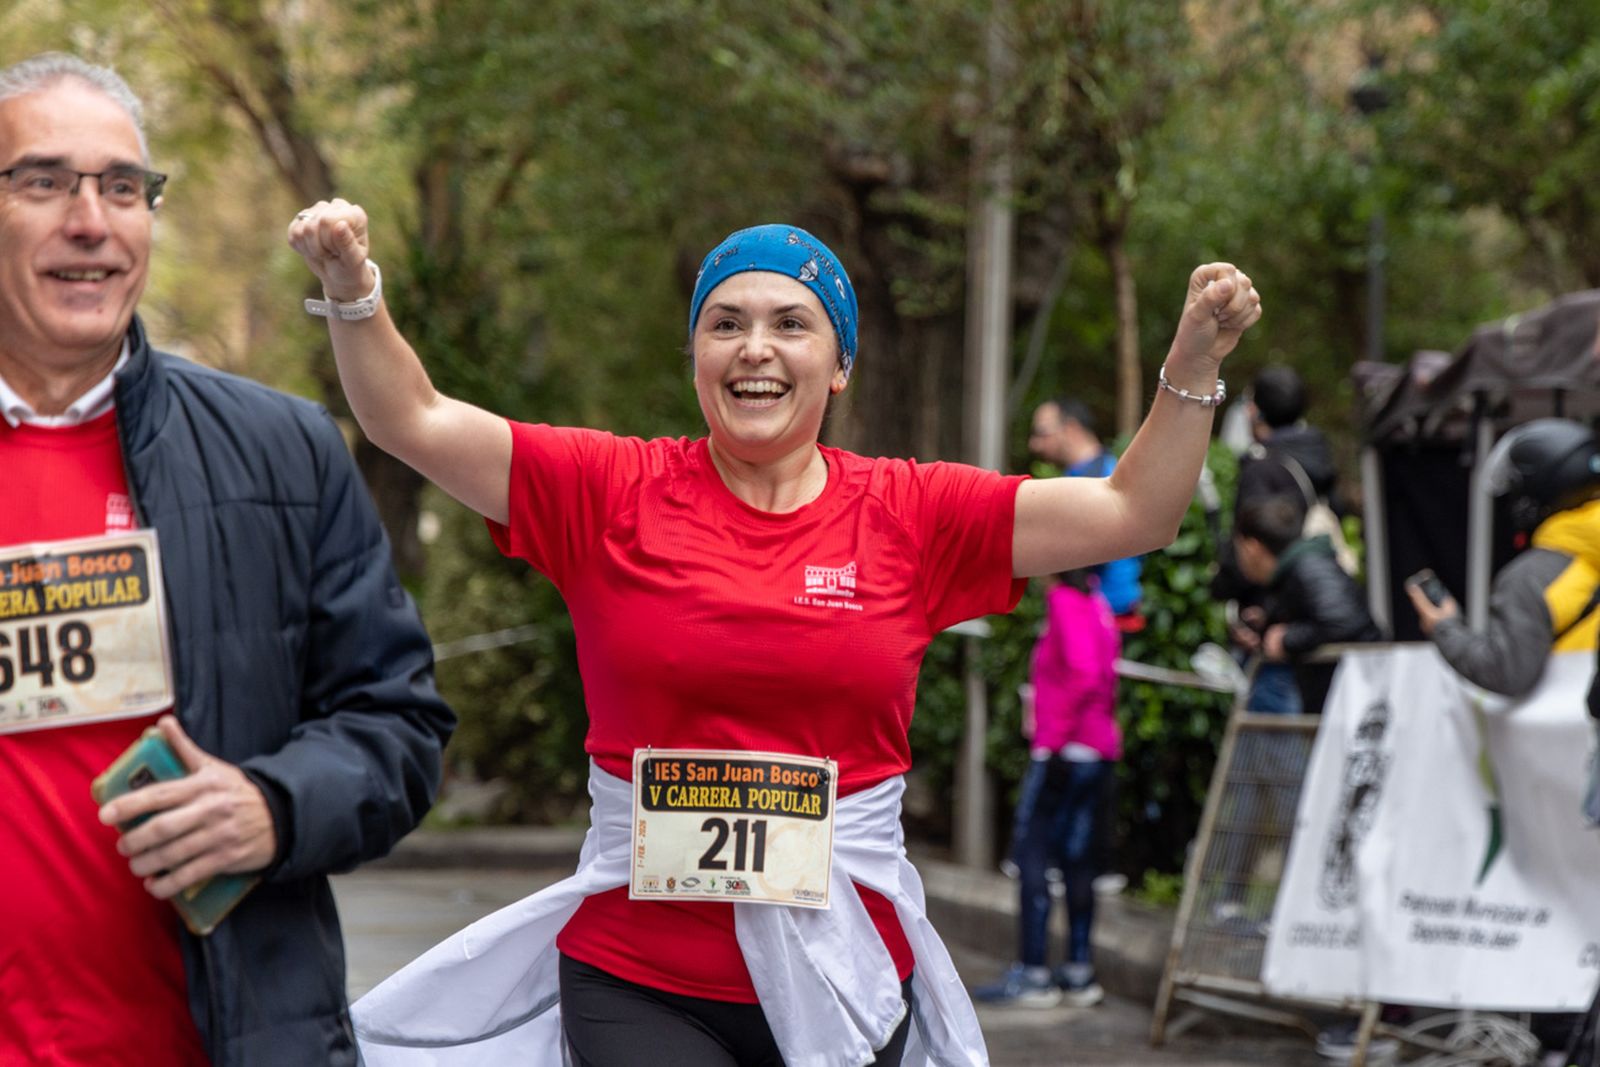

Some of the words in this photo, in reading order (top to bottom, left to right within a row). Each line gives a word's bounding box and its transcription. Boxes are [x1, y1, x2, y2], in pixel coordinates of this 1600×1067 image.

[11, 561, 62, 585] Juan
[67, 552, 133, 577] Bosco
[43, 576, 142, 612] POPULAR
[812, 597, 825, 606] San
[654, 762, 681, 781] IES
[686, 762, 717, 782] San
[722, 763, 764, 783] Juan
[770, 765, 818, 787] Bosco
[649, 785, 662, 806] V
[666, 786, 741, 808] CARRERA
[747, 788, 821, 815] POPULAR
[698, 817, 768, 873] 211
